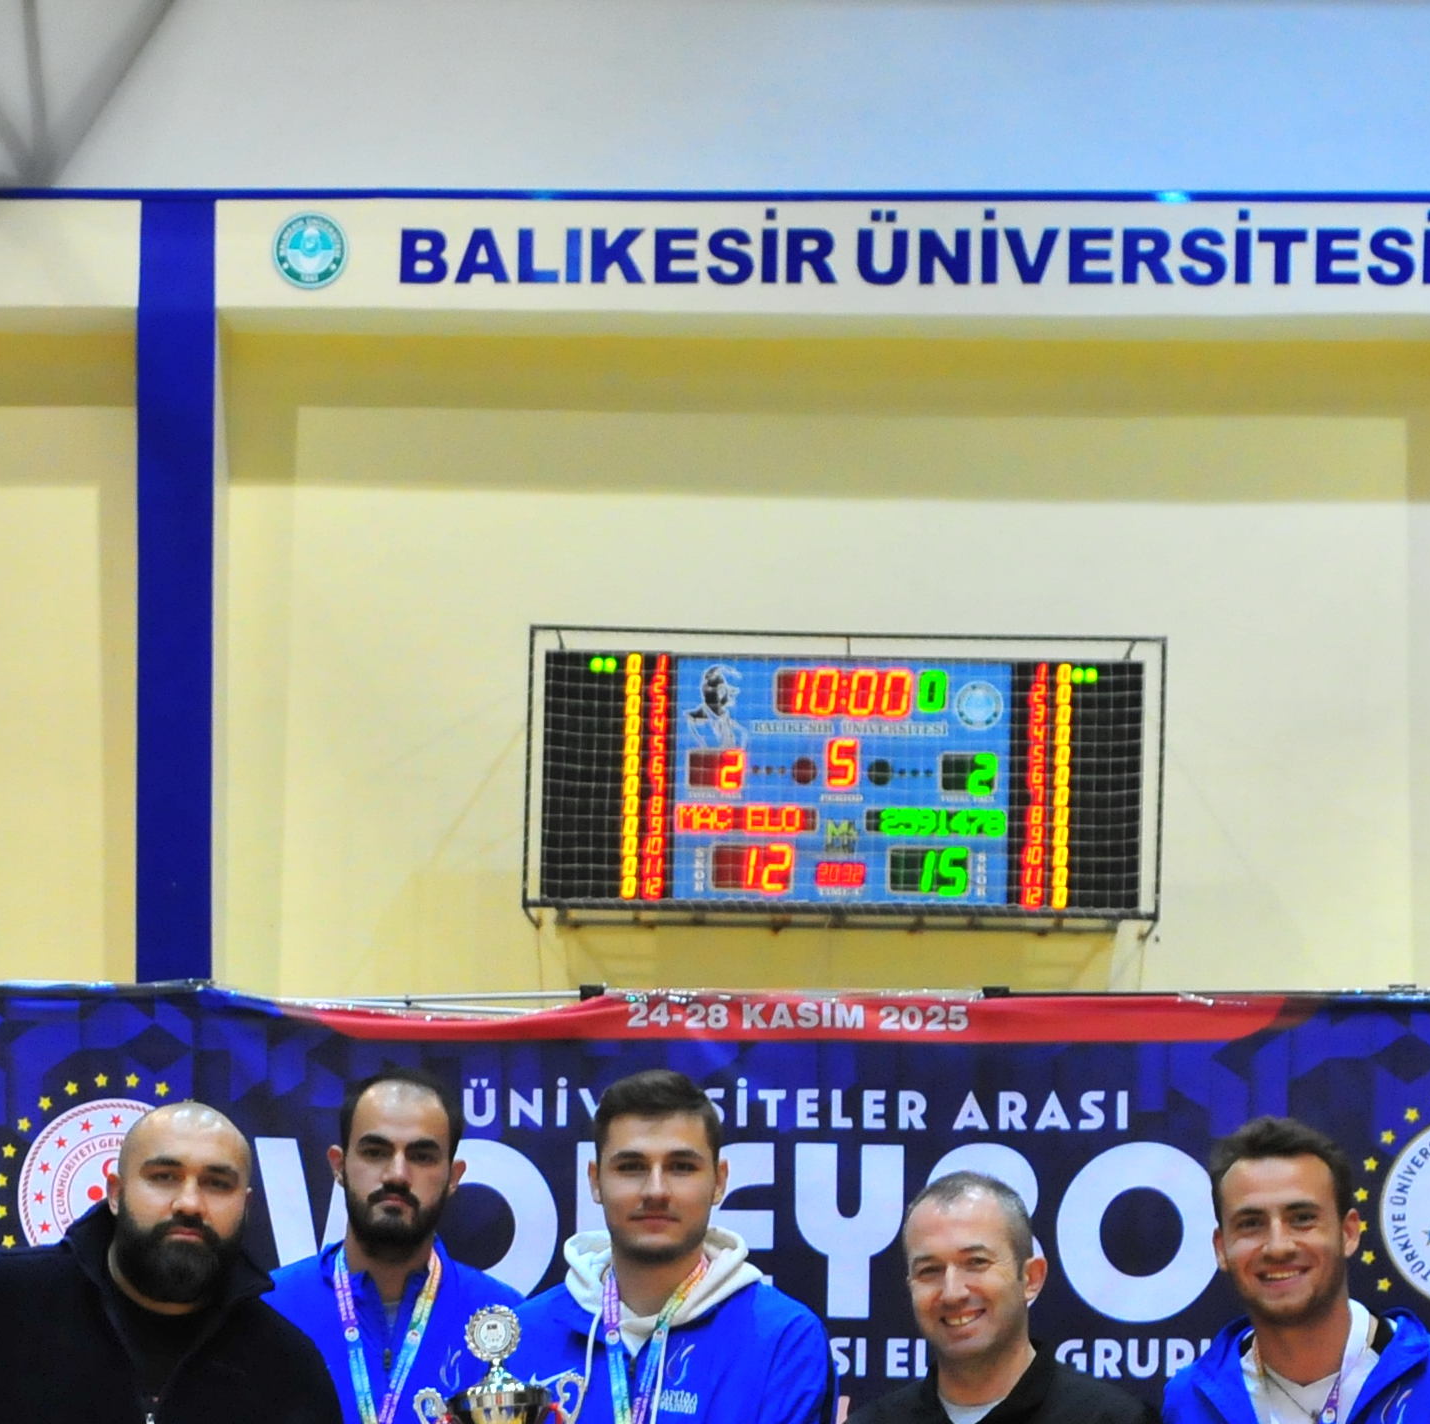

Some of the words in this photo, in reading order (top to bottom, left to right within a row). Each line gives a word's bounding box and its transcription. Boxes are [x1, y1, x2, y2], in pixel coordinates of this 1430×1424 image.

[399, 208, 837, 286] BALIKESİR
[793, 668, 913, 717] 10:00
[718, 750, 746, 793] 2
[827, 738, 860, 791] 5
[967, 752, 999, 796] 2
[744, 843, 795, 894] 12
[919, 846, 968, 897] 15
[627, 1002, 729, 1030] 24-28
[742, 1002, 866, 1030] KASIM
[878, 1005, 969, 1031] 2025
[952, 1090, 1129, 1130] ARASI
[98, 1138, 124, 1149] GEN
